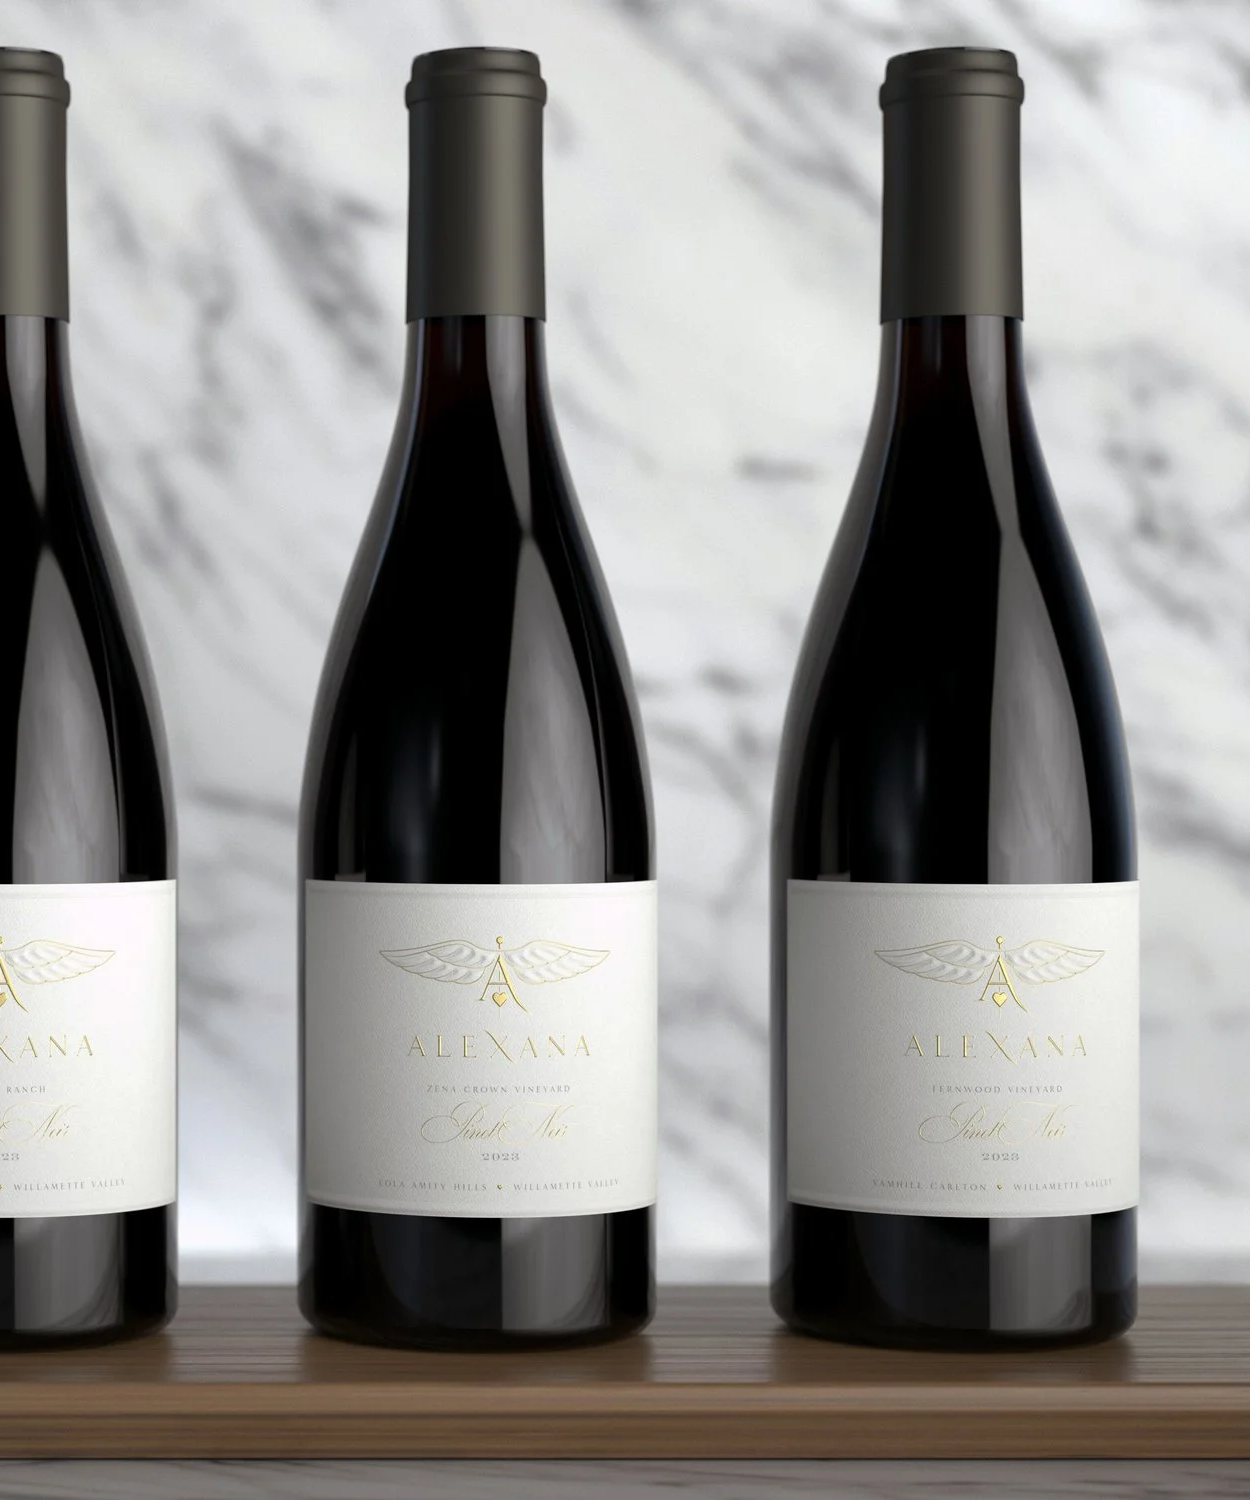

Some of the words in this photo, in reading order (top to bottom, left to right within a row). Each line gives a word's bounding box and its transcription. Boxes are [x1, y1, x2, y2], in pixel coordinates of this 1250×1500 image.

[407, 1030, 591, 1063] ALEXANA
[904, 1030, 1087, 1064] ALEXANA
[6, 1085, 47, 1094] RANCH
[427, 1084, 456, 1093] ZENA
[463, 1085, 507, 1094] CROWN
[515, 1084, 571, 1093] VINEYARD
[932, 1085, 1001, 1094] FERNWOOD
[1008, 1085, 1063, 1094] VINEYARD
[421, 1100, 500, 1144] Pinot
[498, 1101, 576, 1144] Noir
[918, 1100, 998, 1144] Pinot
[996, 1101, 1077, 1144] Noir
[481, 1153, 519, 1162] 2023
[981, 1153, 1019, 1162] 2023
[13, 1181, 85, 1191] WILLAMETTE
[91, 1178, 126, 1188] VALLEY
[412, 1181, 446, 1190] AMITY
[453, 1183, 487, 1192] HILLS
[513, 1181, 583, 1191] WILLAMETTE
[930, 1182, 987, 1191] CARLTON
[1013, 1181, 1079, 1191] WILLAMETTE
